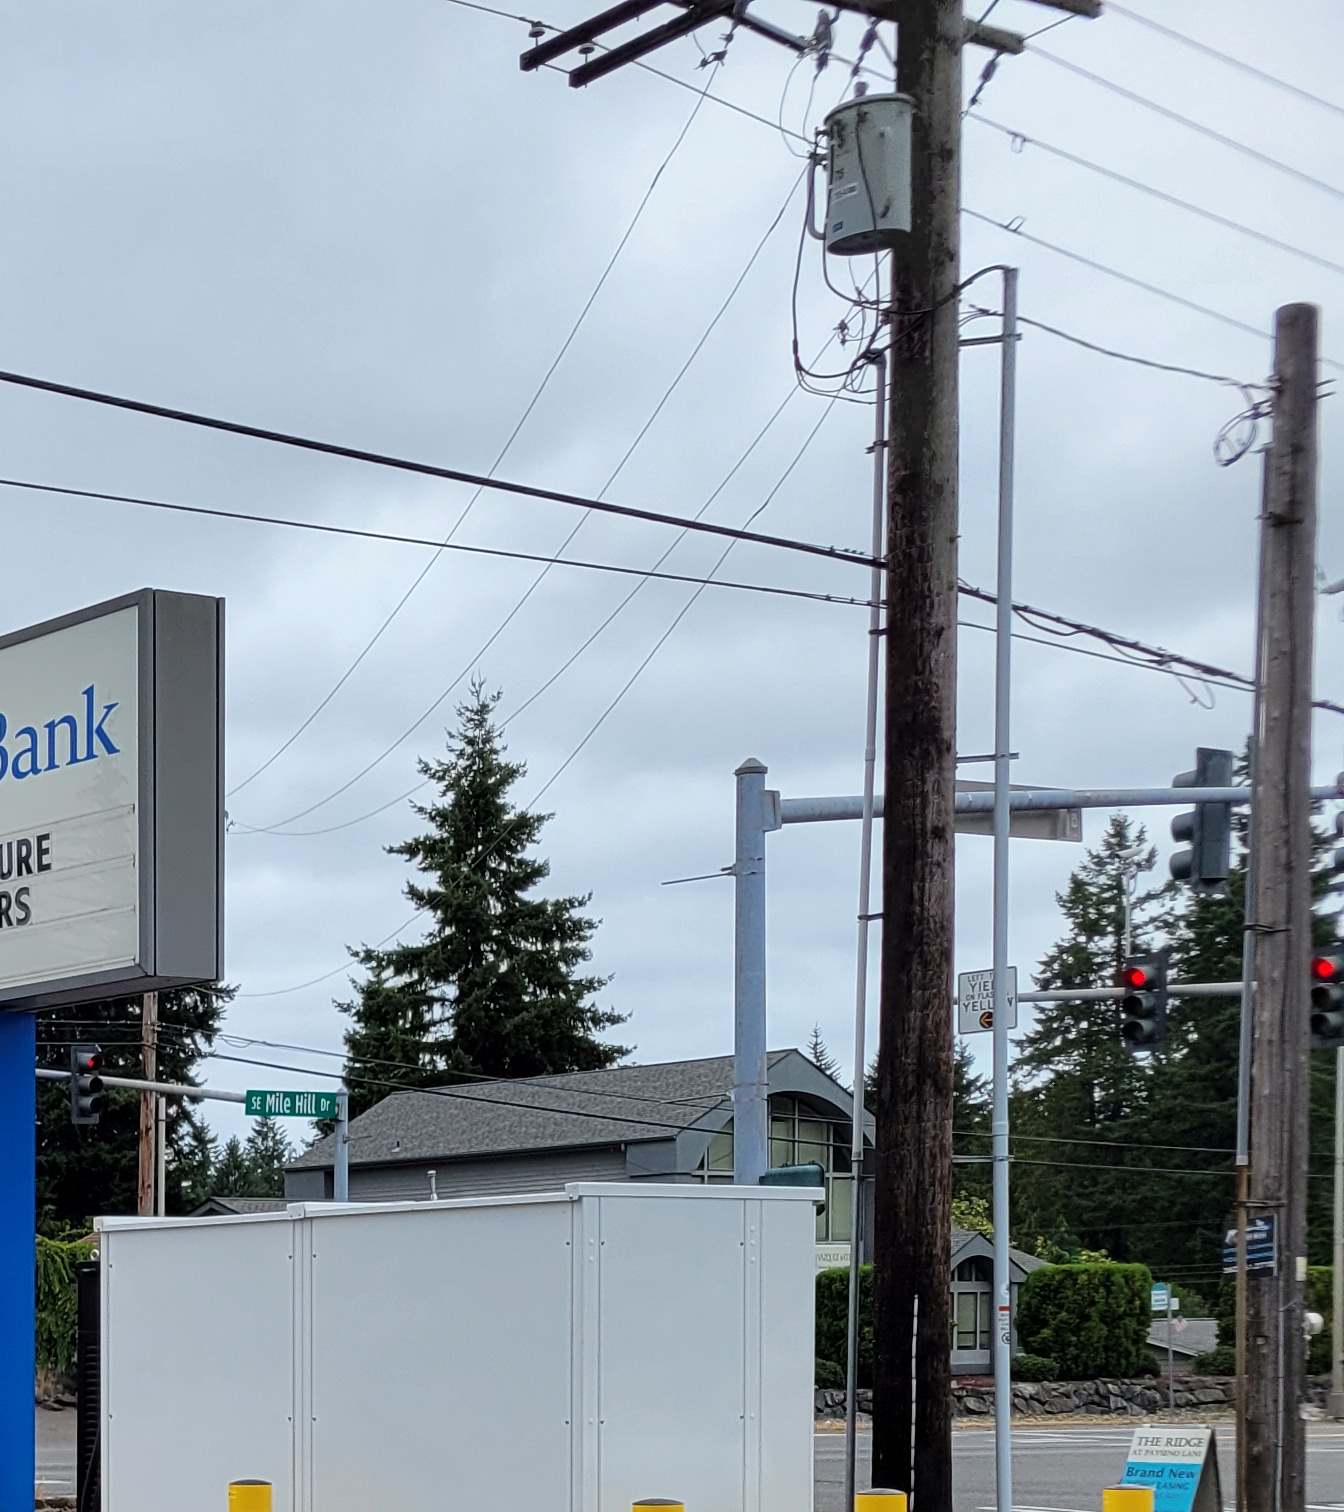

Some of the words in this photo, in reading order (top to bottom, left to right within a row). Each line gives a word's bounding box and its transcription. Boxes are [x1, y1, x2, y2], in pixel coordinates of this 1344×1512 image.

[967, 974, 983, 982] LEFT
[969, 980, 994, 993] YIEL
[965, 993, 975, 1001] ON
[963, 997, 1014, 1012] YELLW
[251, 1096, 262, 1110] SE
[265, 1093, 291, 1114] Mile
[295, 1093, 316, 1114] Hill
[320, 1098, 330, 1112] Dr
[1136, 1436, 1162, 1446] THE
[1164, 1437, 1205, 1447] RIDGE
[1126, 1466, 1165, 1478] Brand
[1169, 1468, 1195, 1479] New
